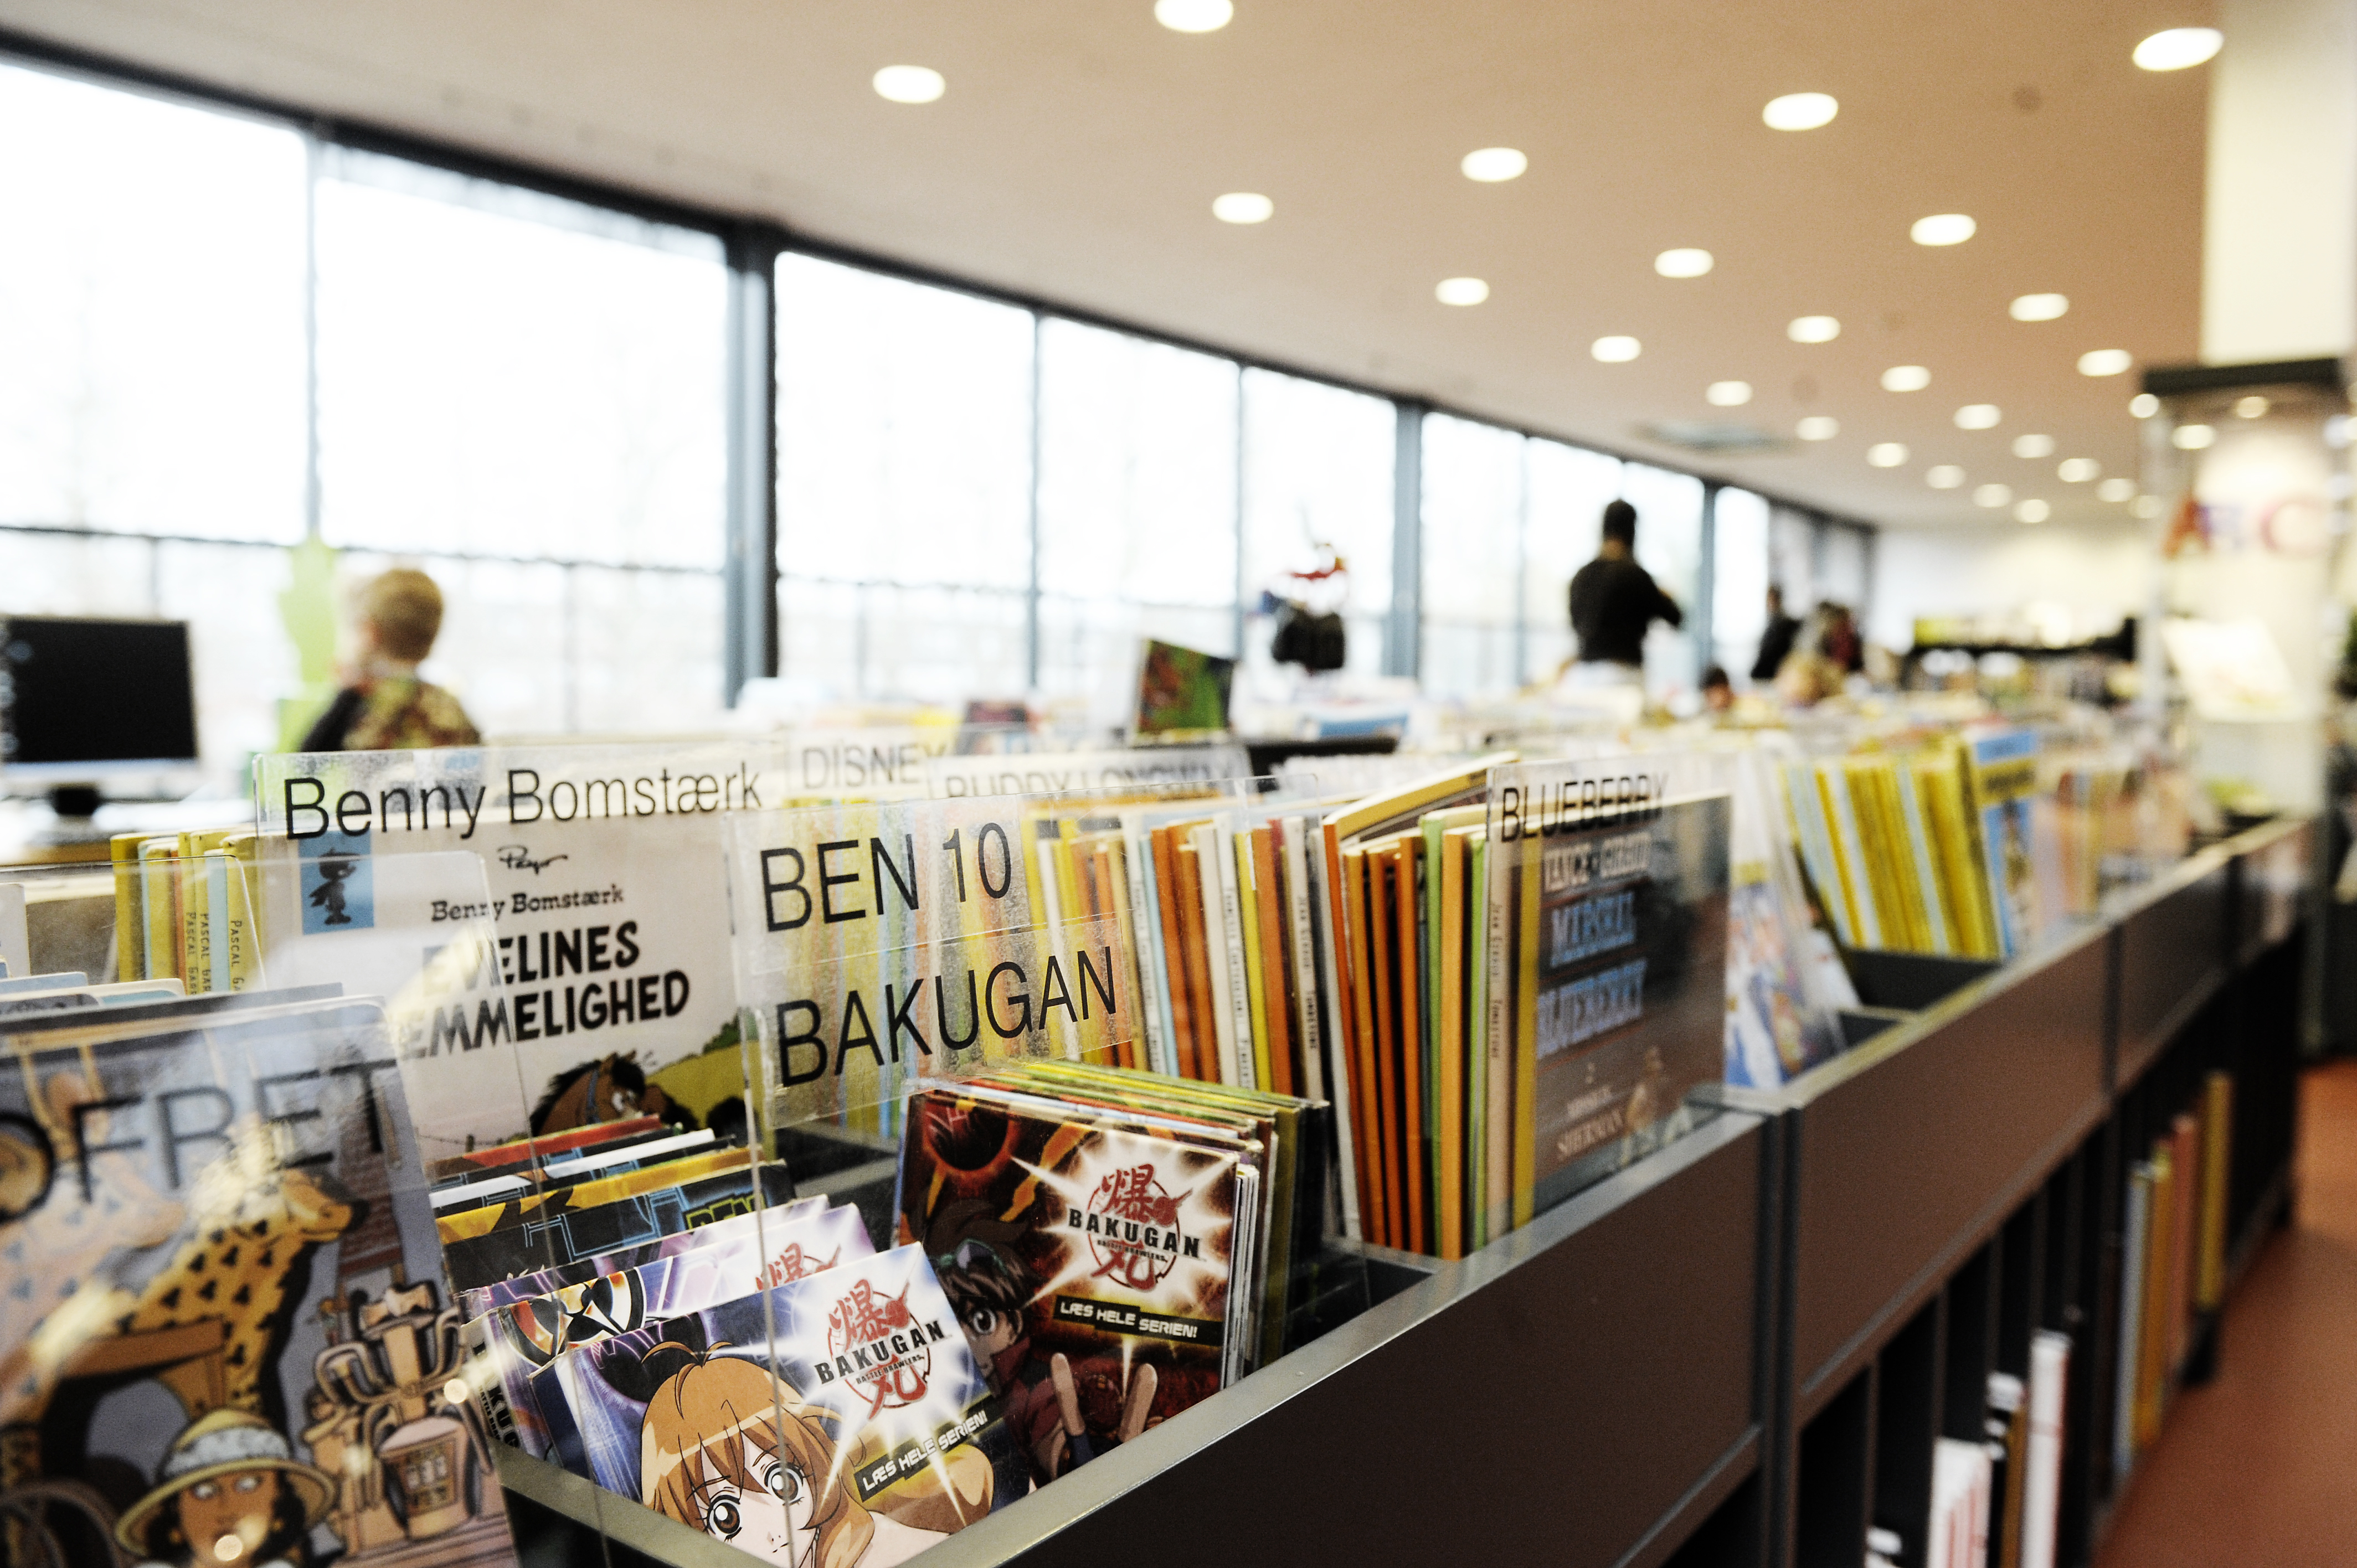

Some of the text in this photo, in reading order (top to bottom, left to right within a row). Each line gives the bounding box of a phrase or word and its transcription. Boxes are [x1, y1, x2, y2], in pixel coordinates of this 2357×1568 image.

[284, 761, 762, 840] Benny Bomstærk
[1501, 771, 1669, 843] BLUEBERRY
[430, 883, 624, 922] Benny Bomstærk
[760, 822, 1011, 932] BEN 10
[230, 920, 243, 967] PASCAL
[777, 946, 1116, 1087] BAKUGAN
[1068, 1208, 1201, 1258] BAKUGAN
[1060, 1301, 1198, 1338] LÆS HELE SERIEN!
[814, 1320, 944, 1385] BAKUGAN
[856, 1354, 923, 1385] BATTLE BRAWLERS
[862, 1410, 988, 1491] LÆS HELE SERIEN!
